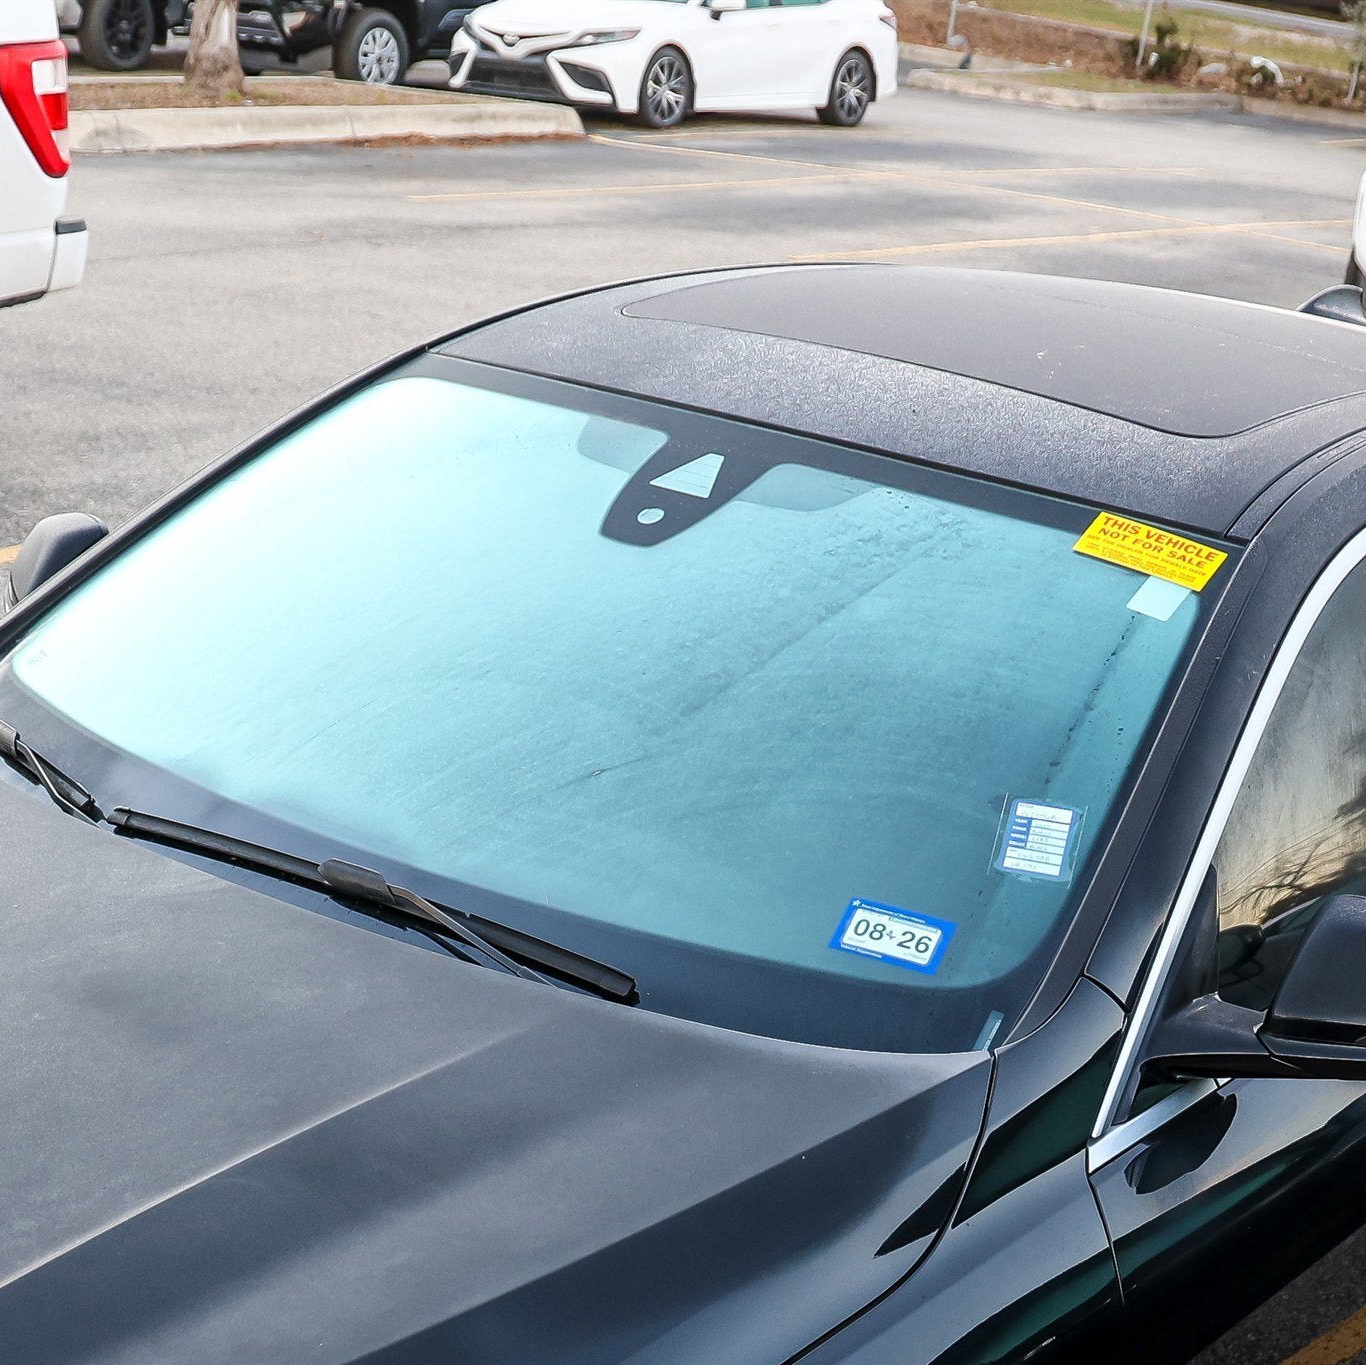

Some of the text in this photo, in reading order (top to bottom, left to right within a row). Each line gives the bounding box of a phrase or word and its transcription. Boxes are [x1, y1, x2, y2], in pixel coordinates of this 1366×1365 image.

[1098, 527, 1208, 568] NOT FOR SALE
[1103, 516, 1219, 562] THIS VEHICLE
[852, 918, 887, 941] 08
[896, 930, 933, 954] 26
